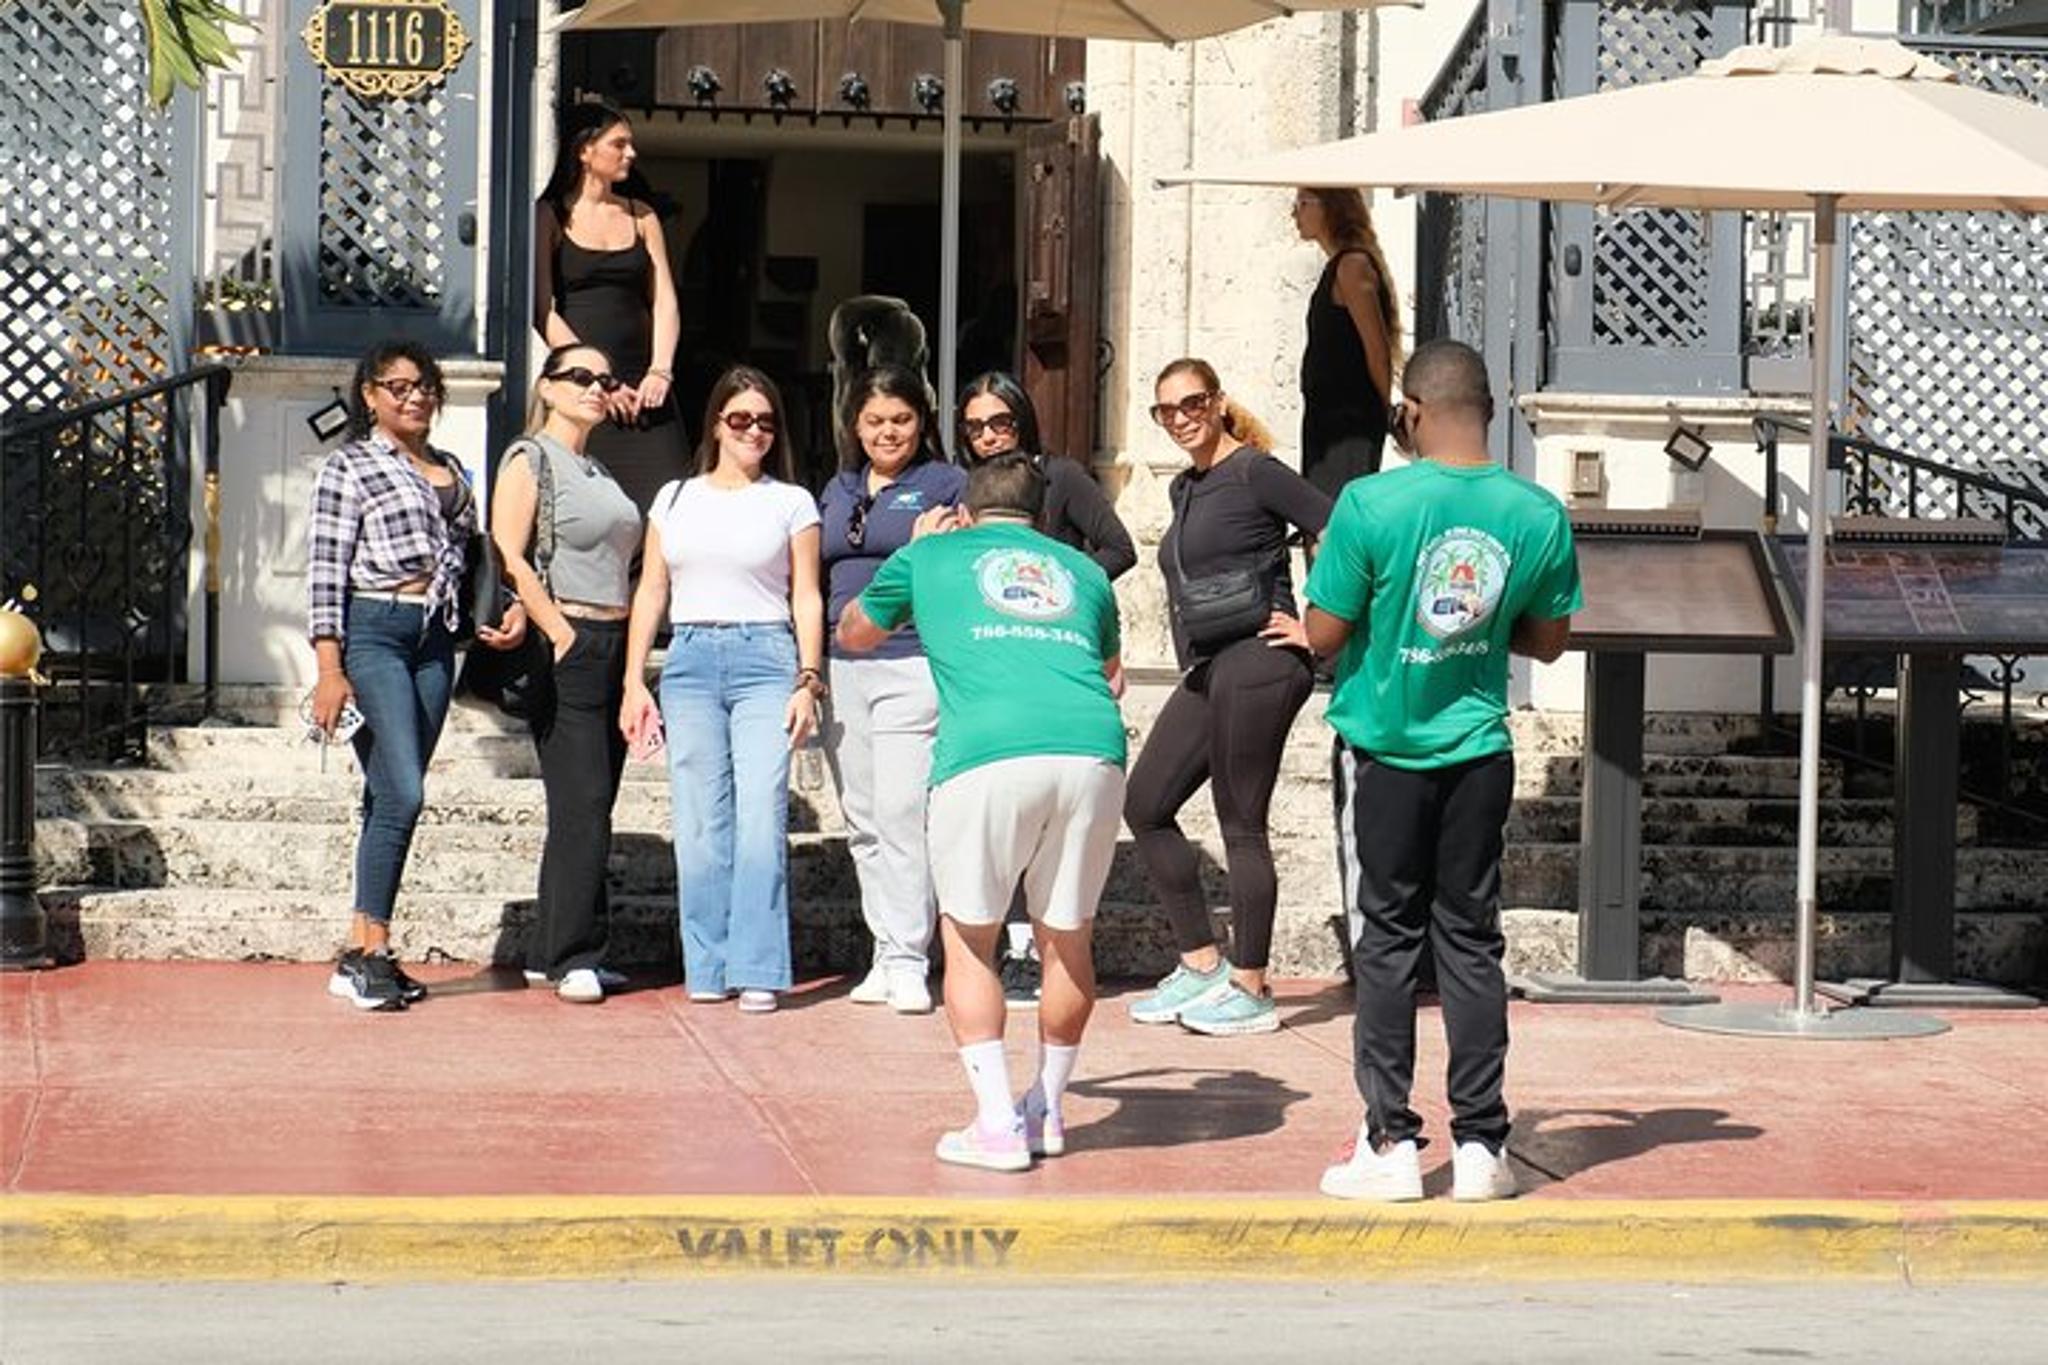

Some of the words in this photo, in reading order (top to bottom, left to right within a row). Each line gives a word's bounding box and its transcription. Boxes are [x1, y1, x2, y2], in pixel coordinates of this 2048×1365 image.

[347, 10, 424, 66] 1116
[677, 1227, 843, 1267] VALET
[863, 1227, 1019, 1268] ONLY
